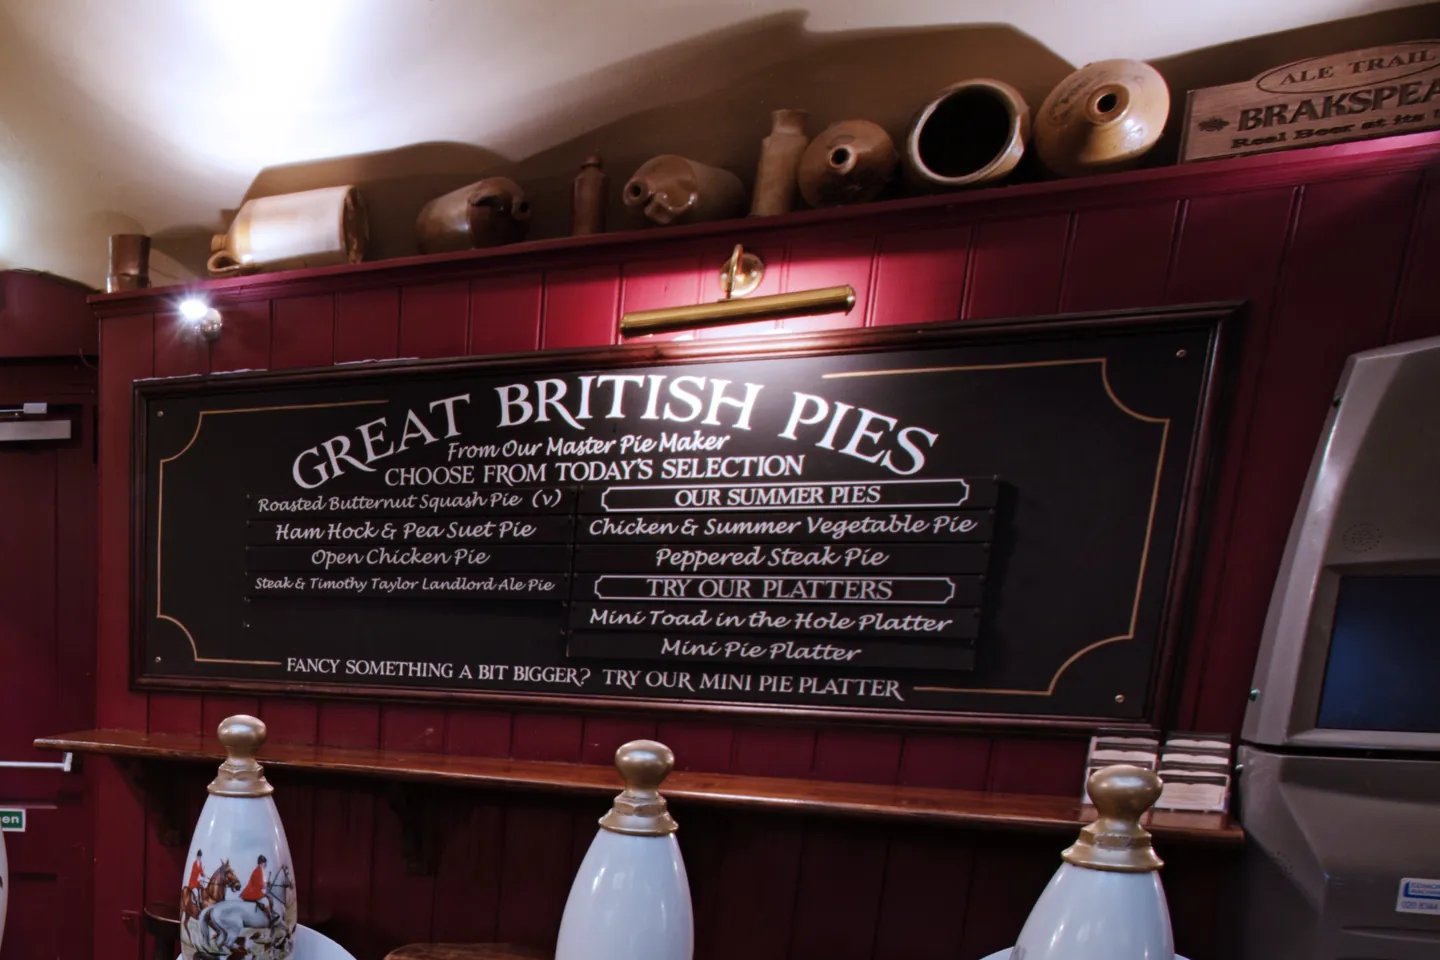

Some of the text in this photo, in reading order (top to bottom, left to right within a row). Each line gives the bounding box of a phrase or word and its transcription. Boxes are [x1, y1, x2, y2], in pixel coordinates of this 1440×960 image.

[1279, 50, 1437, 86] ALE TRAIL
[1293, 124, 1356, 140] Beer
[1361, 118, 1387, 130] at
[1393, 112, 1426, 125] its
[292, 374, 939, 489] GREAT BRITISH PIES
[447, 431, 730, 462] From Our Master Pie Maker
[385, 455, 805, 487] CHOOSE FROM TODAY'S SELECTION
[257, 489, 562, 514] Roasted Butternut Squash Pie (v)
[675, 485, 881, 507] OUR SUMMER PIES
[275, 520, 537, 543] Ham Hock & Pea Suet Pie
[589, 514, 977, 537] Chicken & Summer Vegetable Pie
[311, 547, 491, 570] Open Chicken Pie
[656, 546, 890, 571] Peppered Steak Pie
[255, 576, 556, 594] Steak & Timothy Taylor Landlord Ale Pie
[646, 578, 893, 600] TRY OUR PLATTERS
[589, 608, 953, 633] Mini Toad in the Hole Platter
[661, 639, 862, 663] Mini Pie Platter
[287, 658, 905, 701] FANCY SOMETHING A BIT BIGGER? TRY OUR MINI PIE PLATTER
